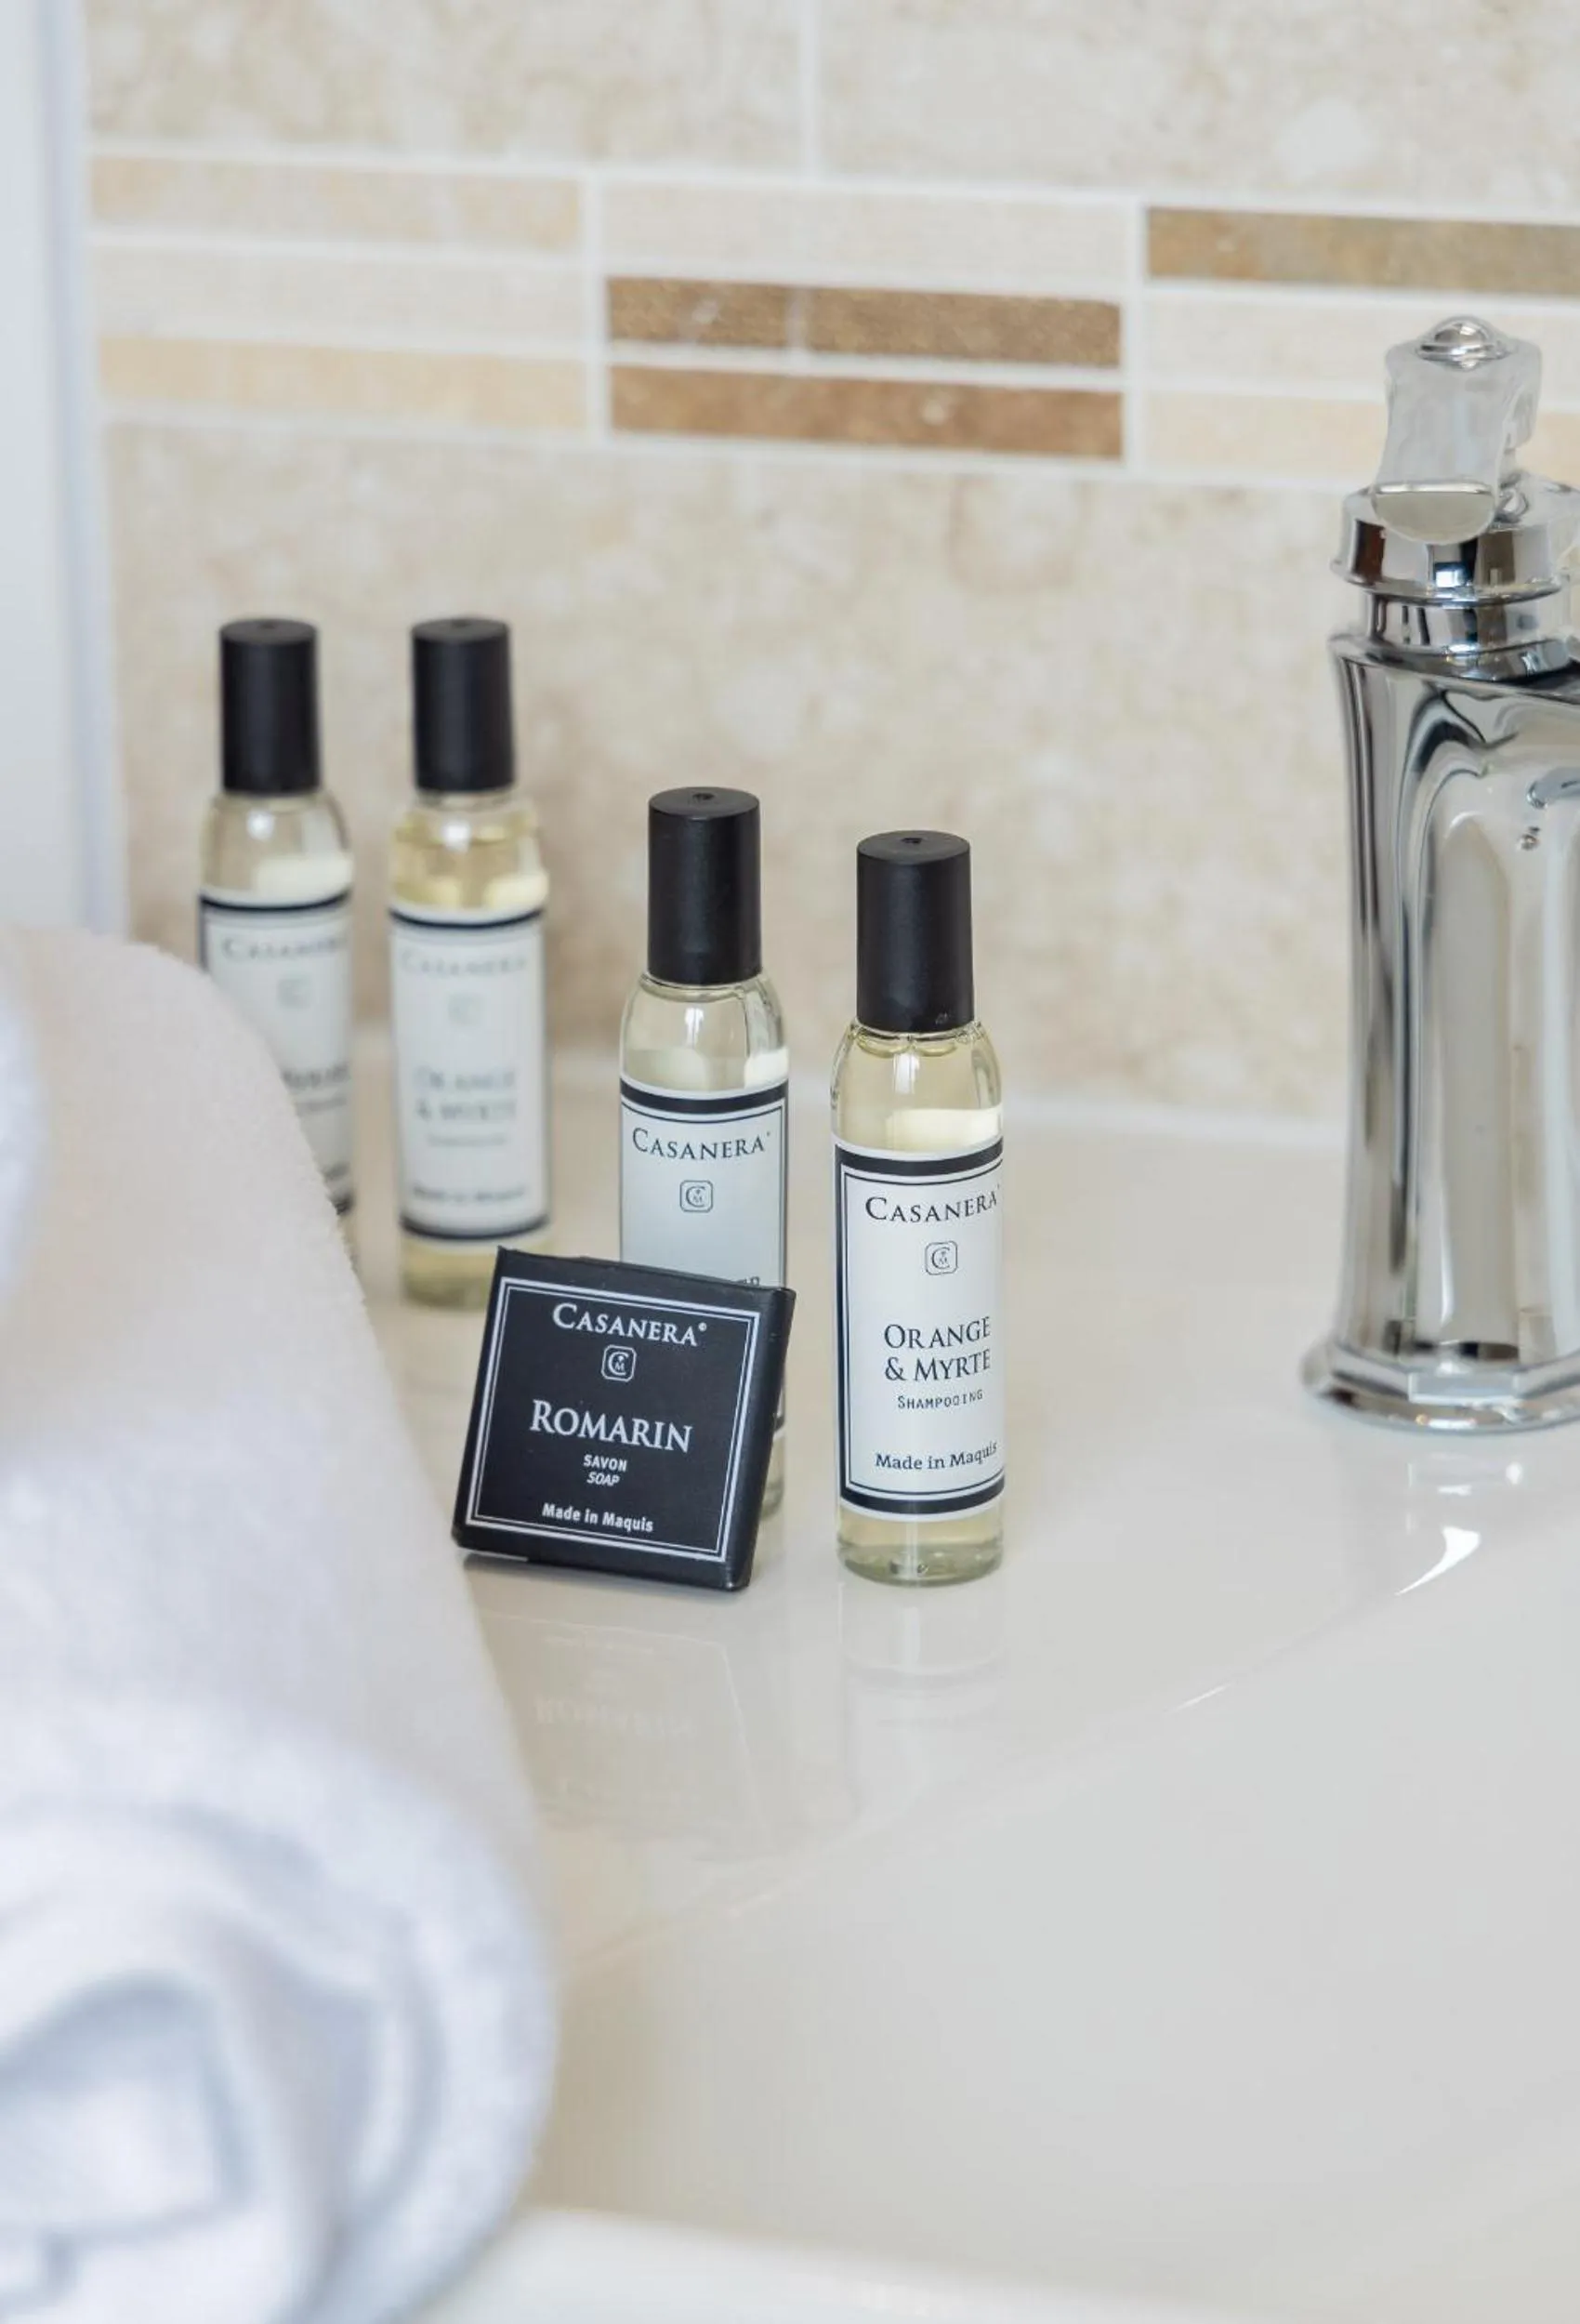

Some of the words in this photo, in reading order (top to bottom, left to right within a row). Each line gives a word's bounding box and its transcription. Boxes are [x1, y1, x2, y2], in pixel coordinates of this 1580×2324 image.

[884, 1315, 991, 1349] ORANGE
[884, 1355, 907, 1381] &
[915, 1348, 991, 1382] MYRTE
[897, 1389, 984, 1410] SHAMPOOING
[529, 1398, 693, 1453] ROMARIN
[583, 1453, 628, 1473] SAVON
[875, 1452, 923, 1471] Made
[927, 1455, 946, 1470] in
[949, 1440, 998, 1469] Maquis
[586, 1471, 621, 1486] SOAP
[542, 1502, 582, 1522] Made
[584, 1508, 599, 1525] in
[601, 1512, 654, 1533] Maquis
